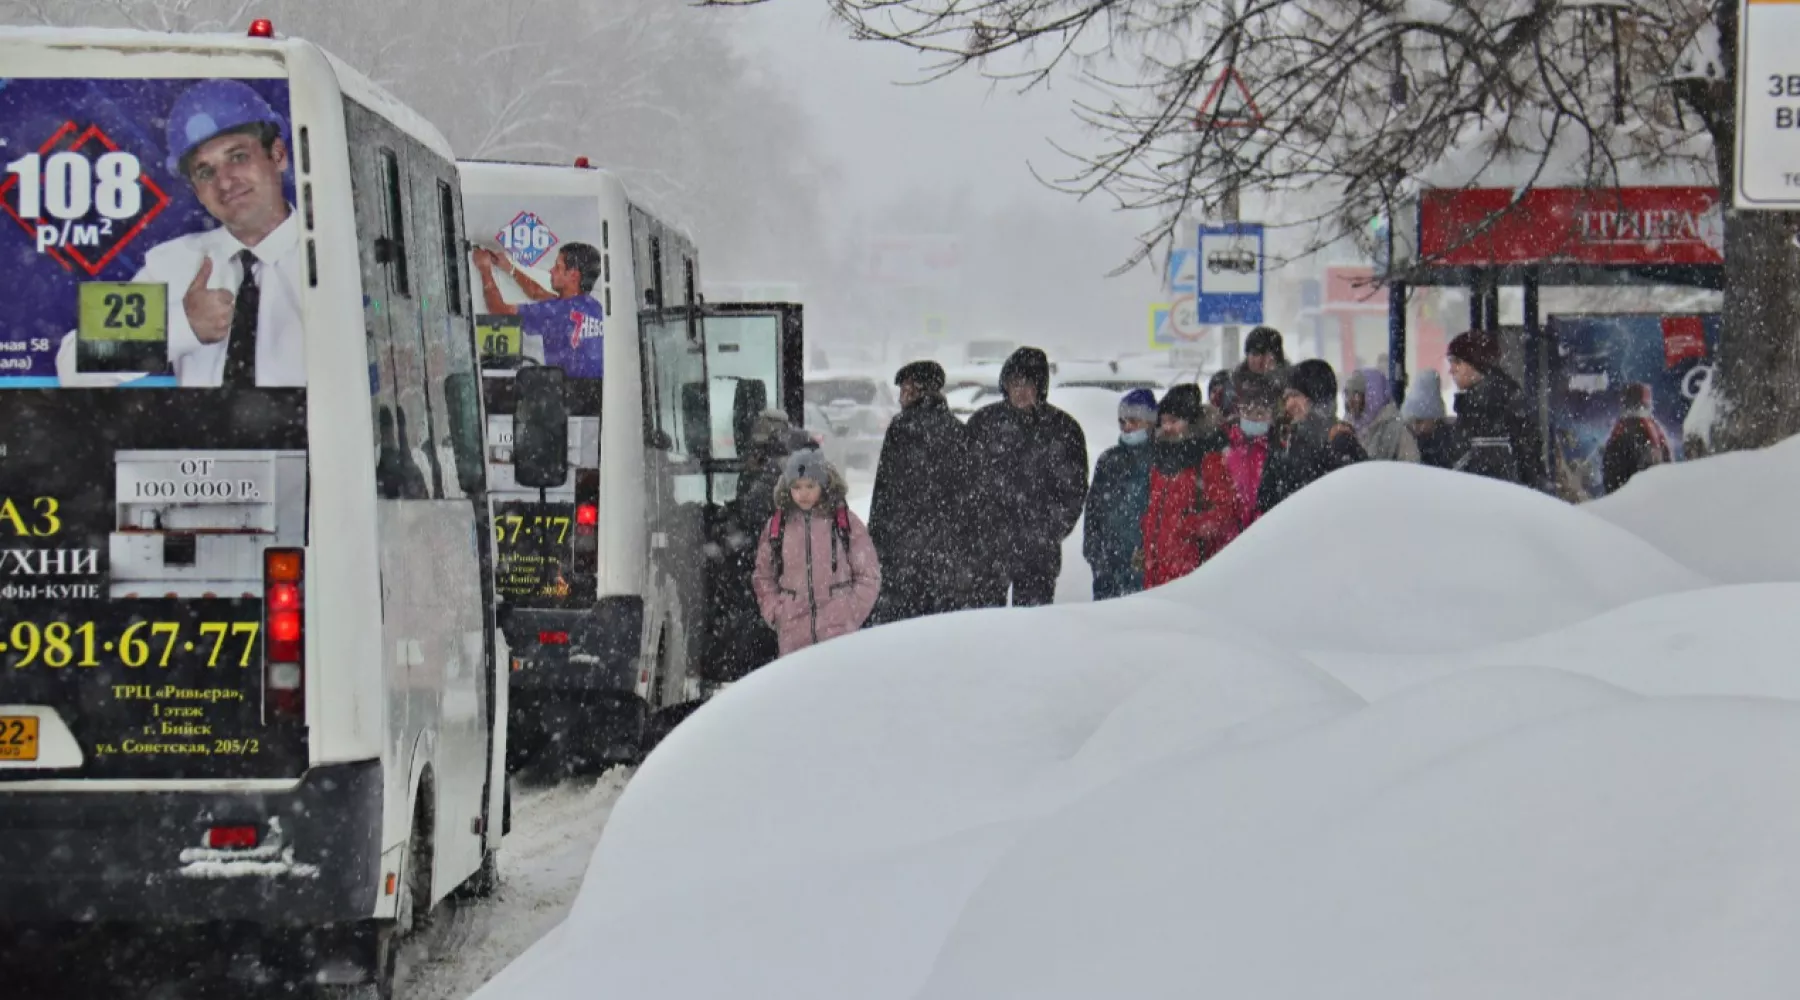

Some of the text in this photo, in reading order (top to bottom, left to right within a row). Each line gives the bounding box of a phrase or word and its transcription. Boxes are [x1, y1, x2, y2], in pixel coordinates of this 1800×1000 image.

[1776, 106, 1800, 129] В
[6, 152, 141, 219] 108
[500, 225, 550, 249] 196
[103, 292, 147, 329] 23
[30, 338, 50, 351] 58
[483, 334, 509, 357] 46
[180, 459, 214, 477] ОТ
[134, 480, 176, 498] 100
[183, 480, 233, 498] 000
[0, 496, 61, 537] АЗ
[112, 685, 244, 703] ТРЦ «Ривьера»,
[152, 703, 203, 717] 1 этаж
[143, 722, 212, 735] г. Бийск
[96, 739, 259, 757] ул. Советская, 205/2
